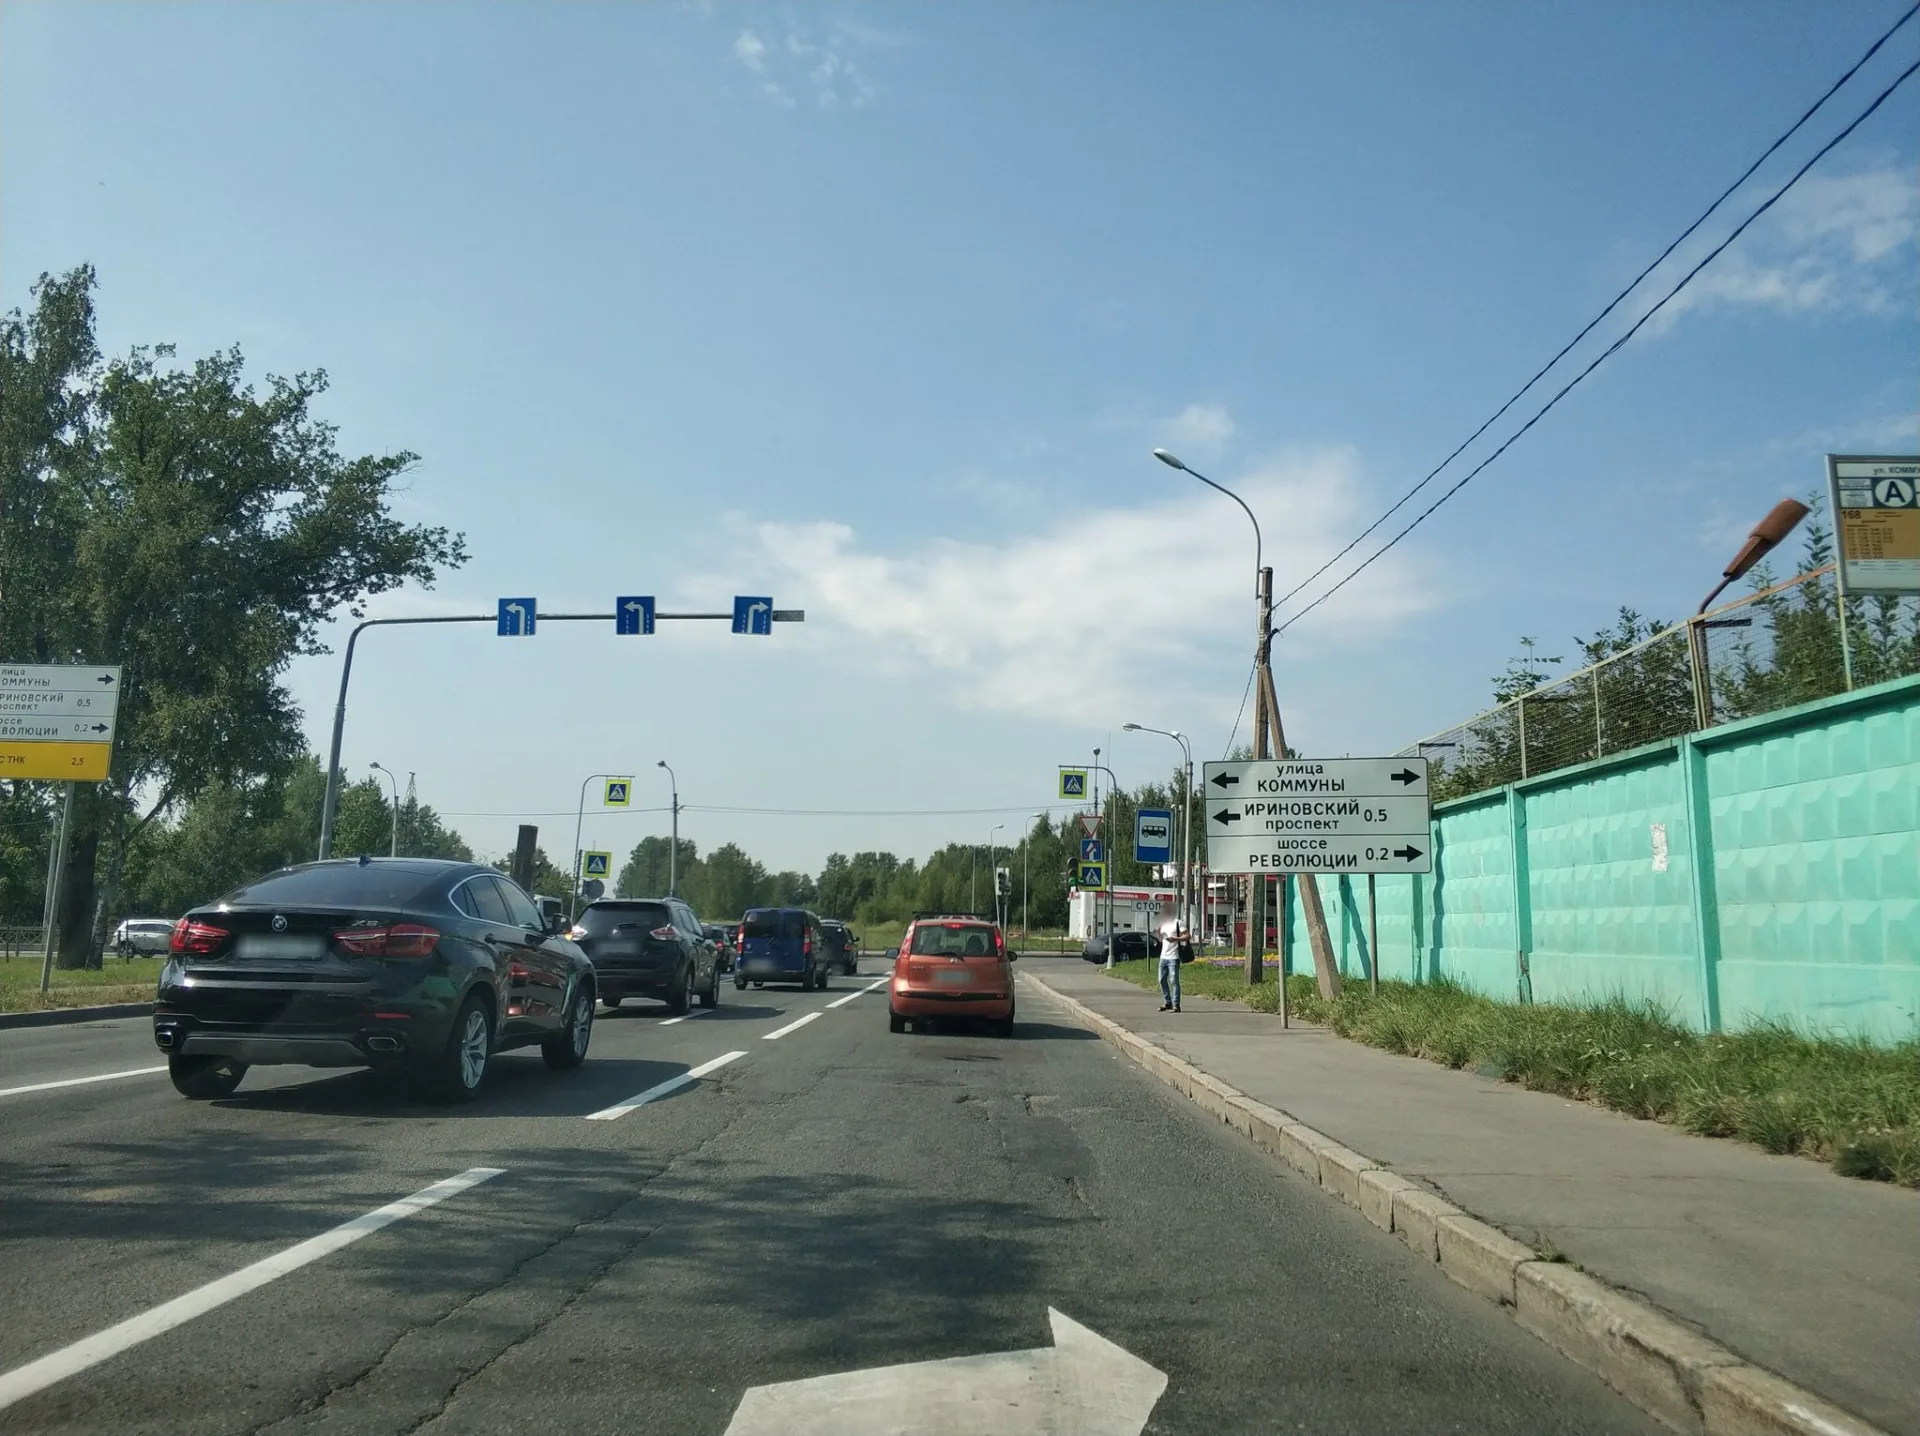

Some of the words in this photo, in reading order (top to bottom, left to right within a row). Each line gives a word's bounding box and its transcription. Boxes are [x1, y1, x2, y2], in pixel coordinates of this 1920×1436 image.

[1884, 481, 1906, 503] А
[77, 698, 91, 708] 0,5
[74, 724, 89, 733] 0,2
[8, 755, 26, 764] ТНК
[71, 757, 84, 766] 2,5
[1277, 764, 1324, 778] улица
[1257, 778, 1345, 792] КОММУНЫ
[1245, 799, 1359, 816] ИРИНОВСКИЙ
[1364, 809, 1387, 823] 0,5
[1265, 817, 1340, 832] проспект
[1277, 839, 1327, 849] шоссе
[1249, 854, 1358, 869] РЕВОЛЮЦИИ
[1365, 848, 1388, 862] 0,2
[1136, 902, 1162, 910] СТОП
